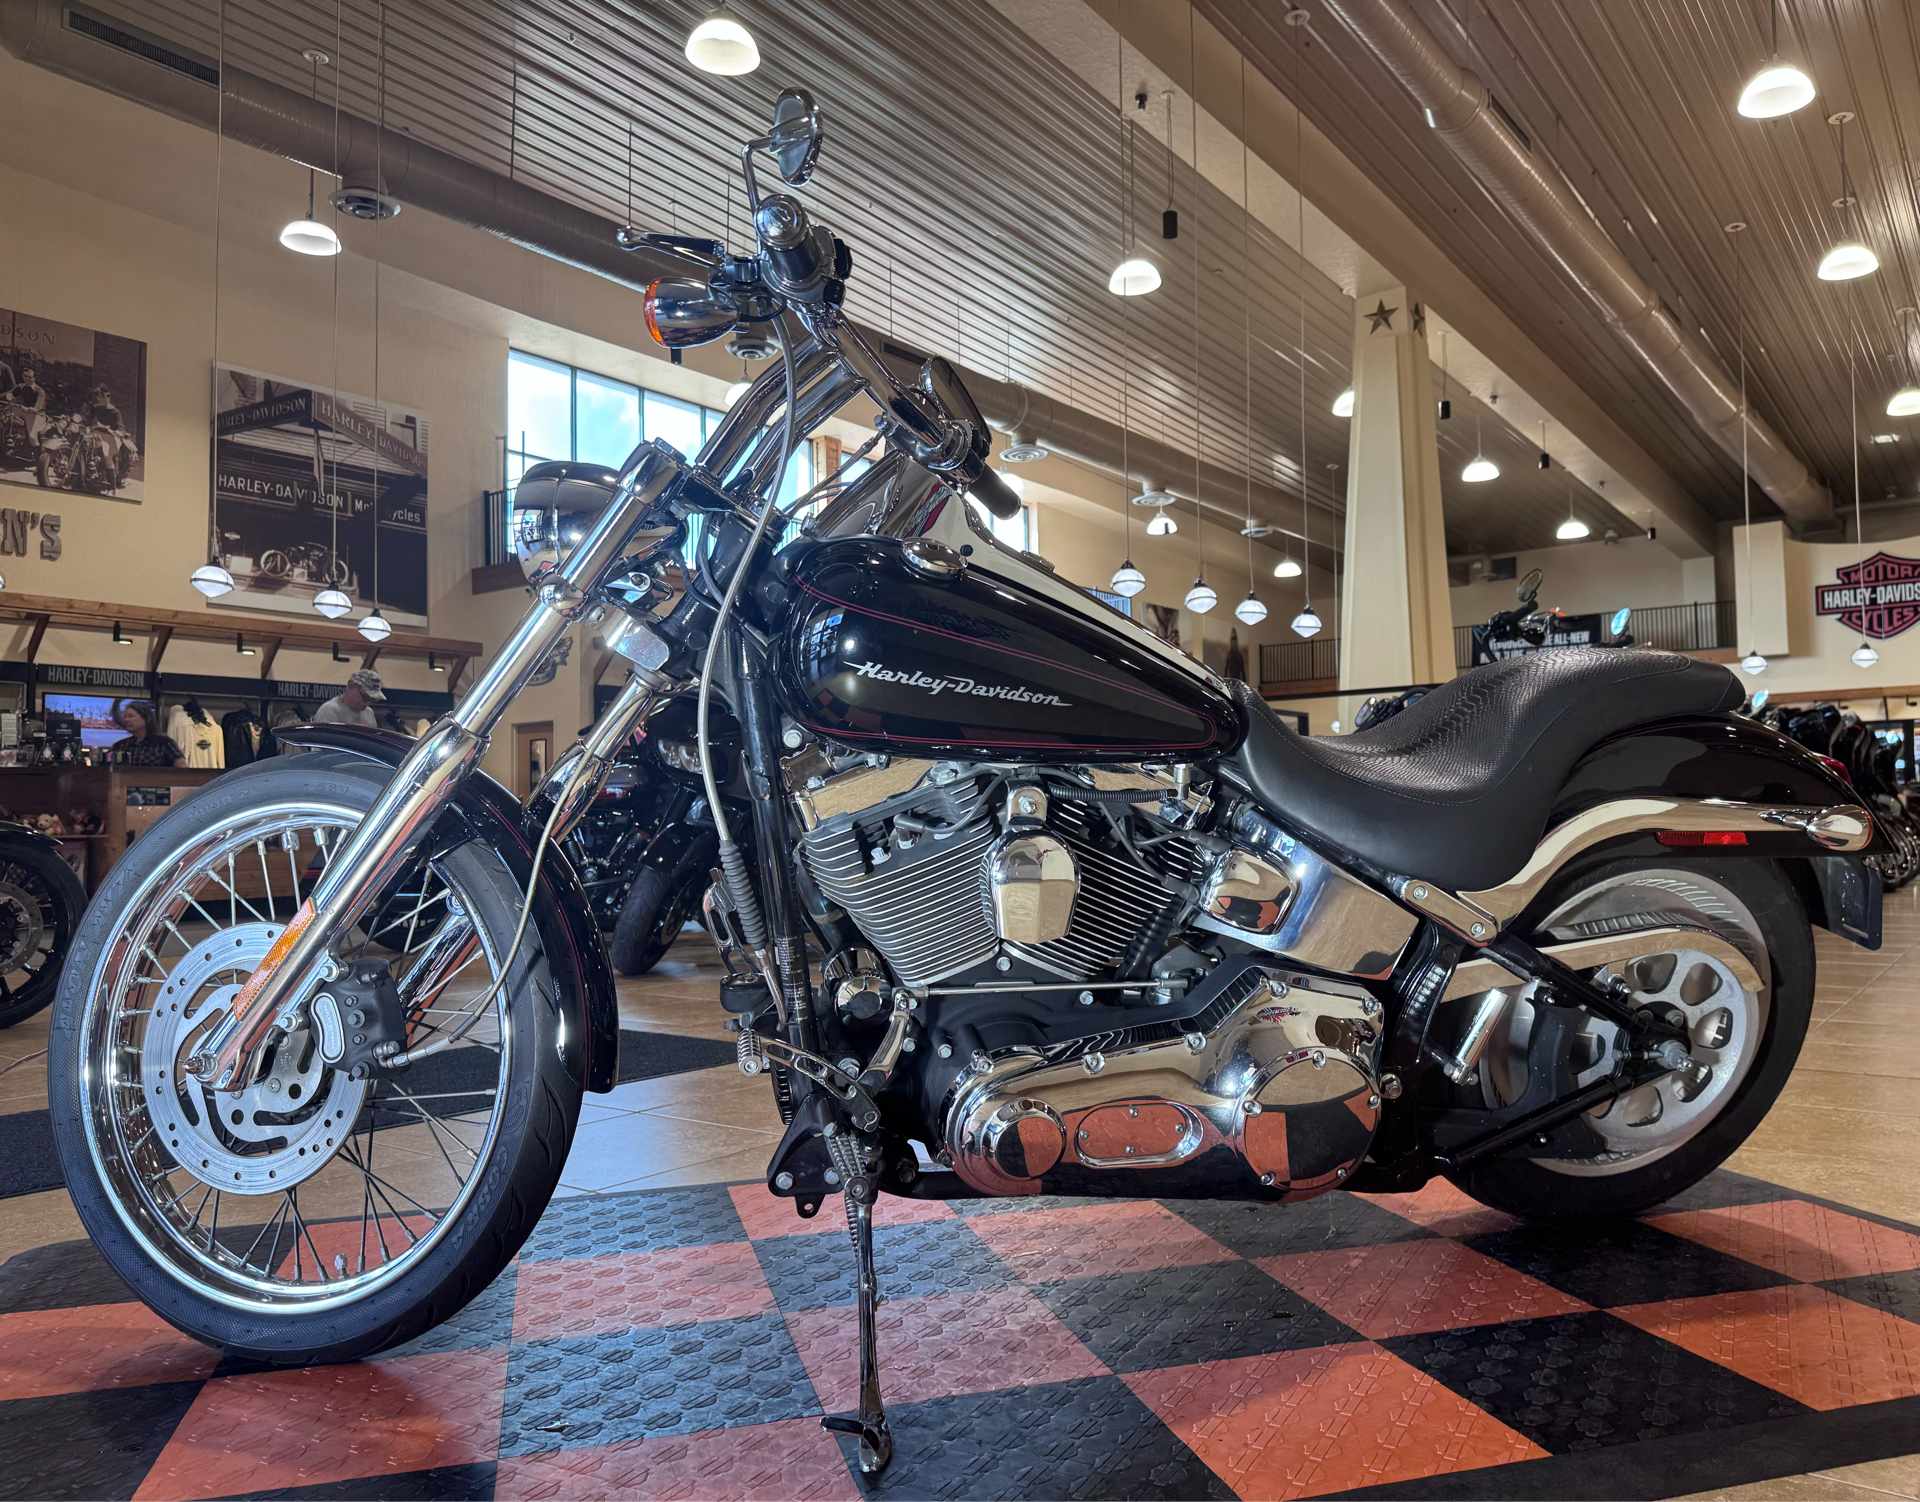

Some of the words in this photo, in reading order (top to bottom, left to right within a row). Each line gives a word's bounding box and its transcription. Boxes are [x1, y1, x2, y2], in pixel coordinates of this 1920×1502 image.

[217, 397, 306, 429] ARLEY-DAVIDSON
[0, 507, 62, 562] N'S
[1850, 560, 1913, 583] MOTOR
[1851, 607, 1915, 632] CYCLES
[1554, 630, 1590, 645] ALL-NEW
[48, 666, 145, 688] HARLEY-DAVIDSON
[843, 661, 1073, 707] Harley-Davidson
[277, 682, 346, 700] HARLEY-DAVIDS
[450, 1145, 509, 1251] COBRA
